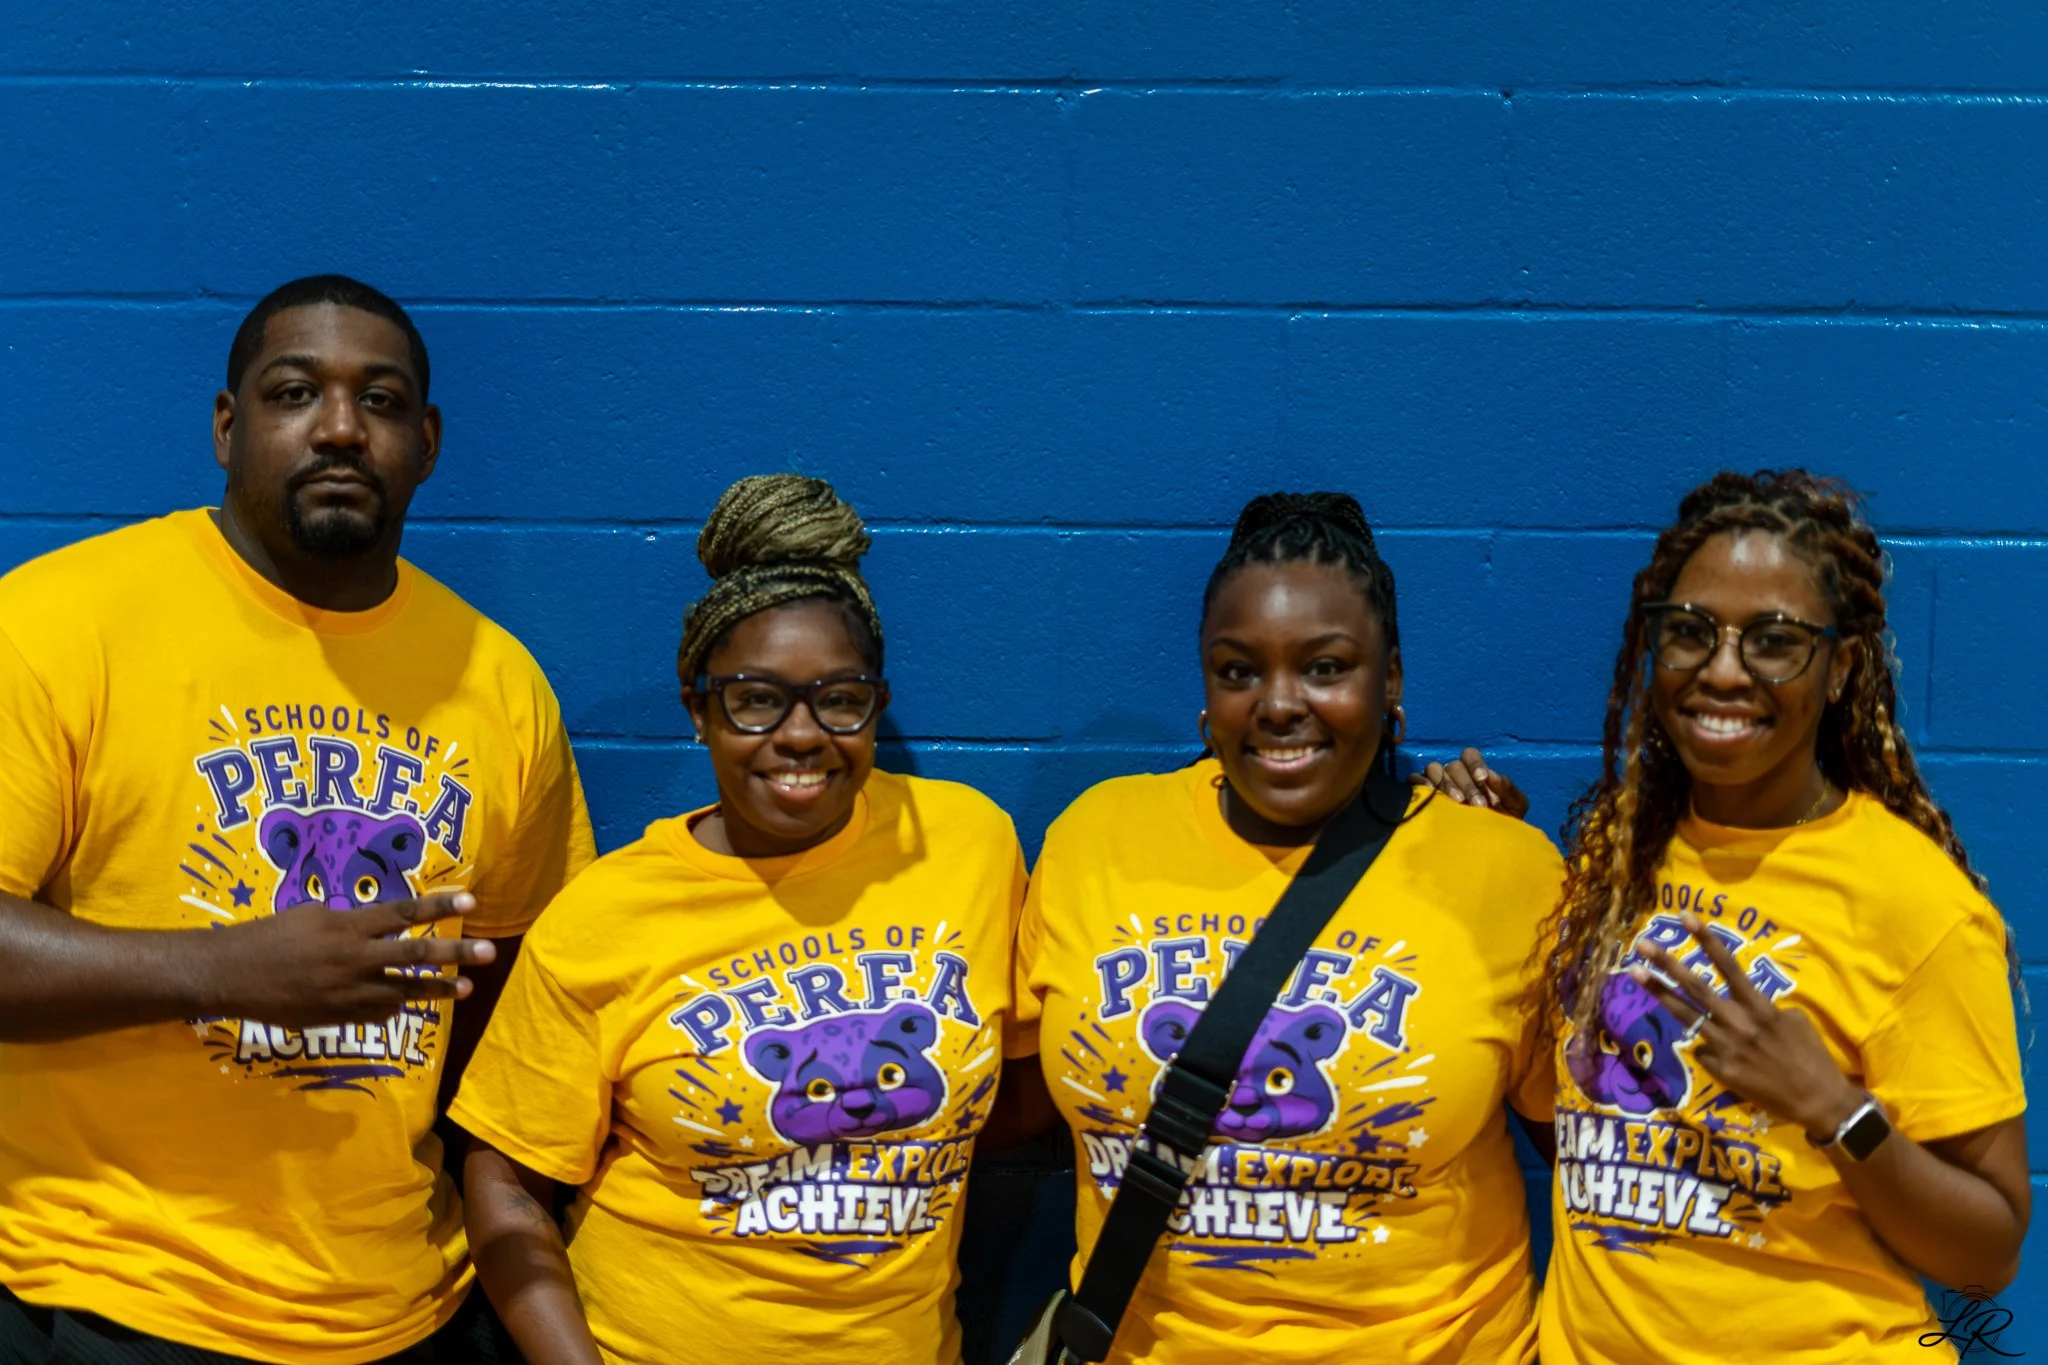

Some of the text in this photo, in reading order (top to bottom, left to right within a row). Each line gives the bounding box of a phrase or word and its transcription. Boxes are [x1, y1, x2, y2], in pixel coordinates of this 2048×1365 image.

[245, 704, 440, 757] SCHOOLS OF
[195, 733, 473, 860] PEREA
[1153, 913, 1381, 954] SCHO OF
[1661, 883, 1779, 941] OOLS OF
[709, 926, 926, 987] SCHOOLS OF
[668, 950, 982, 1056] PEREA
[735, 1183, 937, 1237] ACHIEVE.
[1163, 1186, 1361, 1244] CHIEVE.
